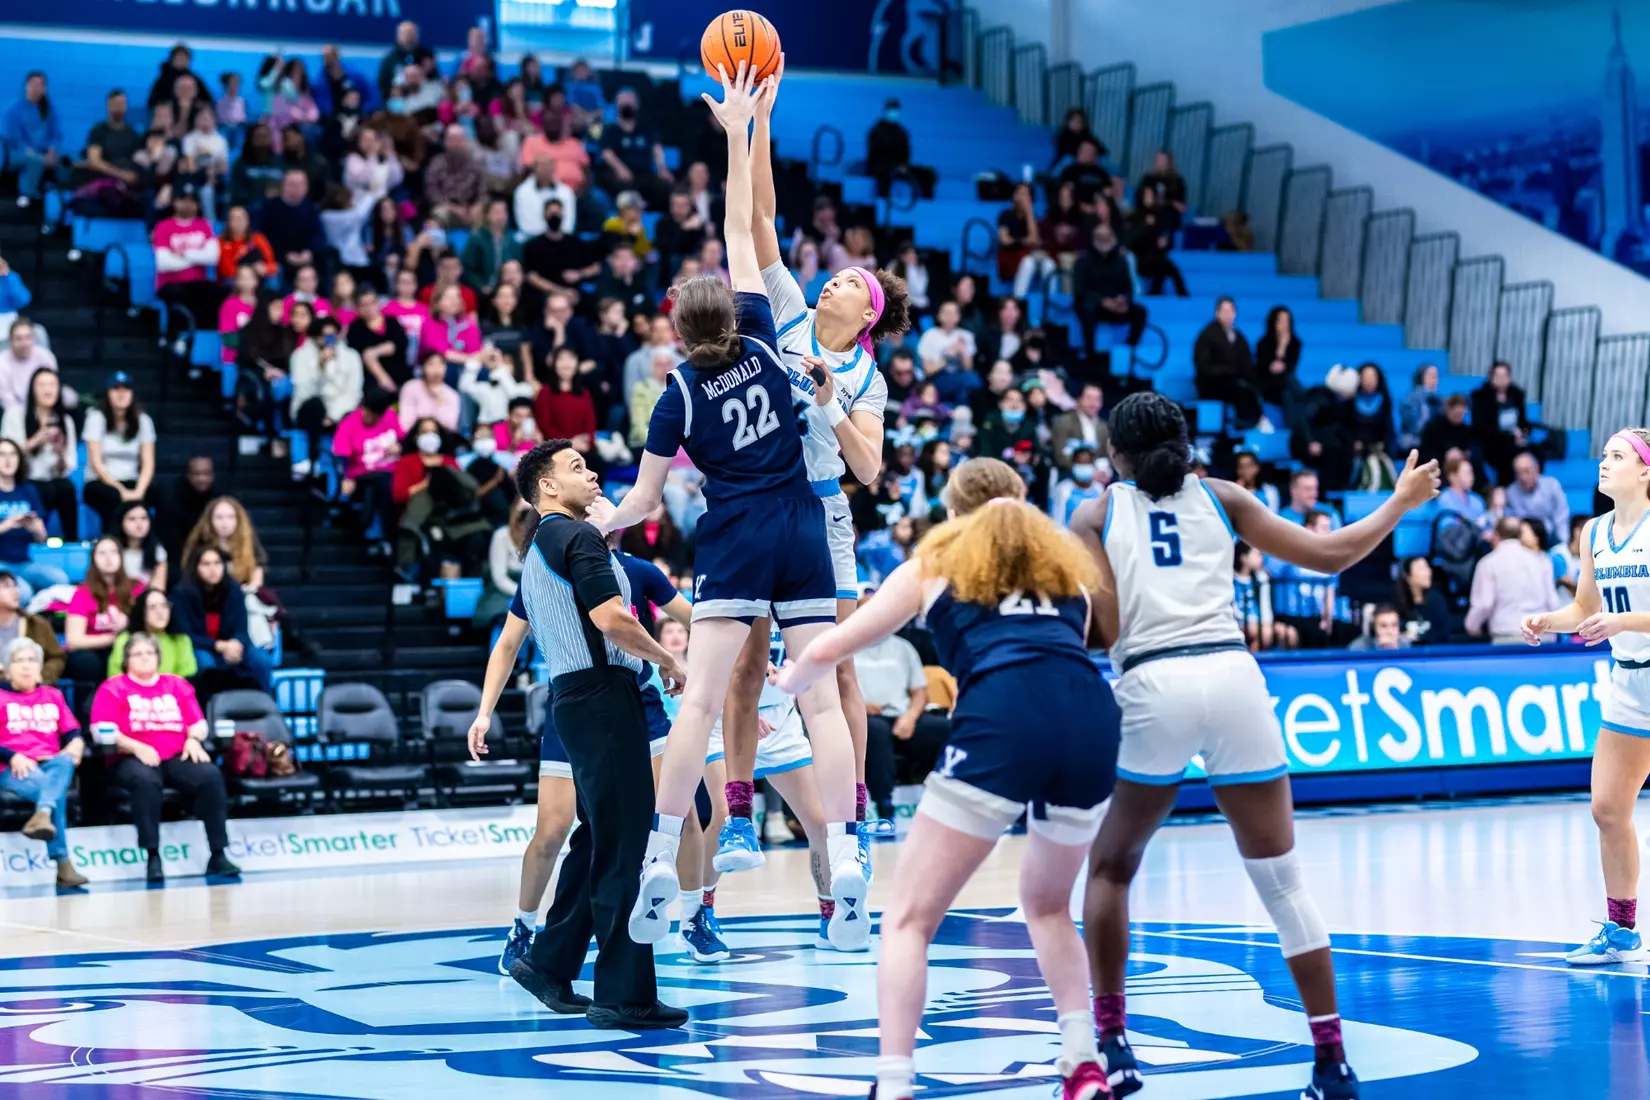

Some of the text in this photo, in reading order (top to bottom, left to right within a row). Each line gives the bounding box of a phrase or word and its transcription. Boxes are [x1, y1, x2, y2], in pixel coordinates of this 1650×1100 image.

[732, 12, 746, 47] ELITE
[701, 355, 762, 401] McDONALD
[721, 384, 780, 451] 22
[1149, 511, 1183, 567] 5
[1594, 564, 1650, 581] OLUMBIA
[1602, 586, 1631, 613] 10
[1270, 660, 1613, 767] etSmart
[940, 745, 967, 776] Y
[227, 830, 398, 860] cketSmarter
